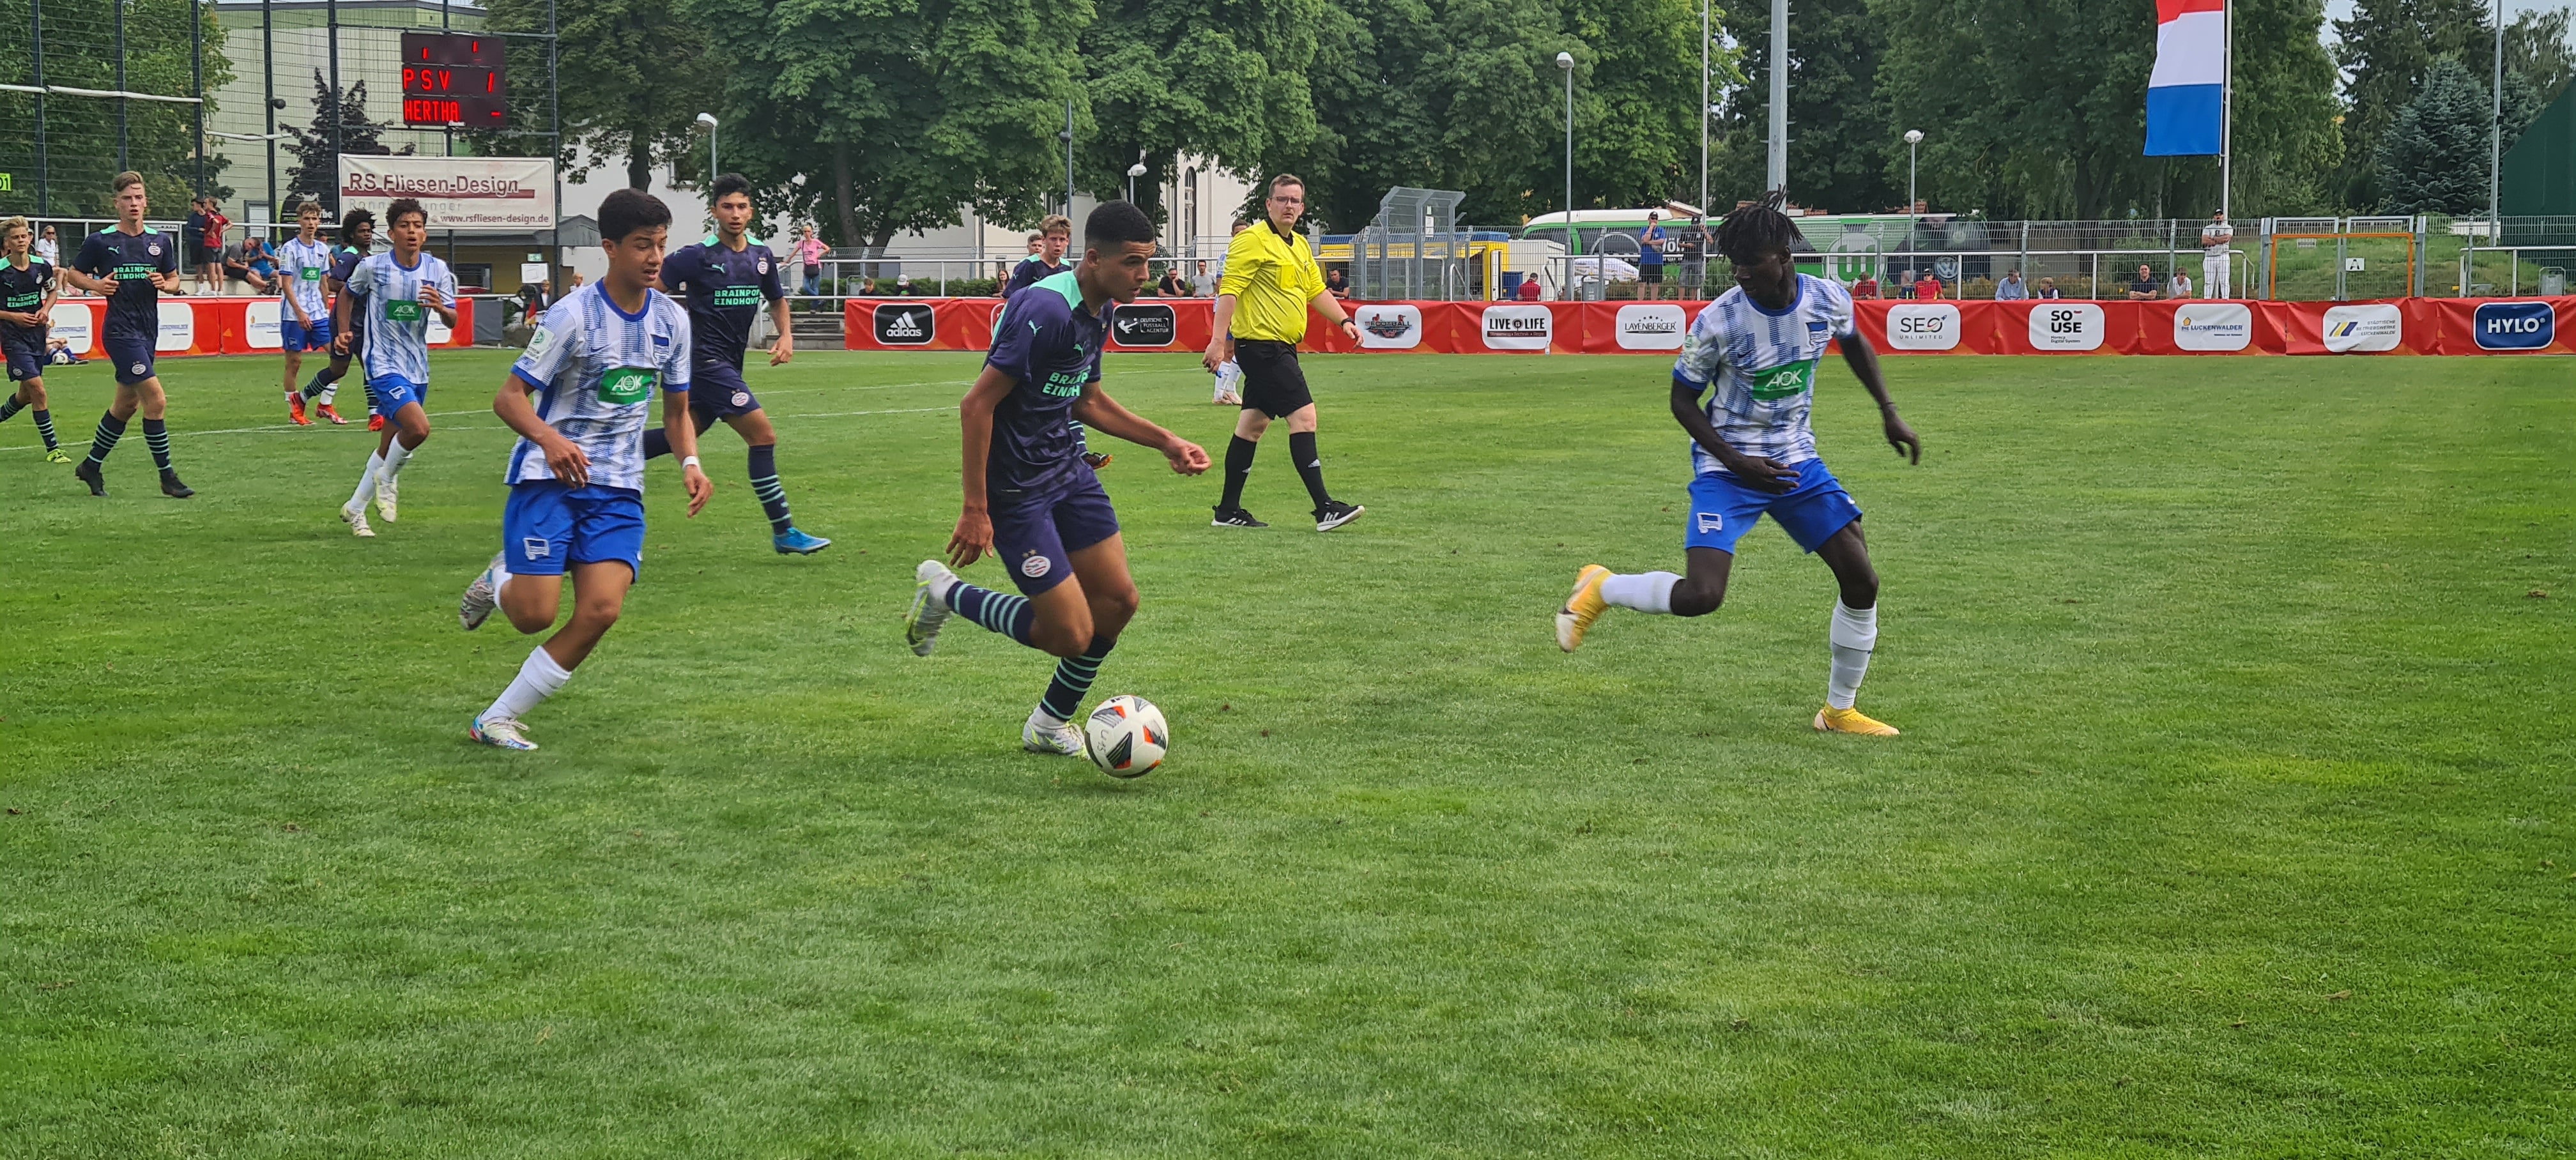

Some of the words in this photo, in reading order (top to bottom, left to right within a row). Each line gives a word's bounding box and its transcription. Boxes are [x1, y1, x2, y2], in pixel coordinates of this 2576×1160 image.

[404, 99, 461, 122] HERTHA
[350, 173, 376, 190] RS
[383, 174, 518, 196] Fliesen-Design
[440, 214, 549, 225] www.rsfliesen-design.de
[2350, 259, 2360, 270] A
[394, 305, 415, 314] AOK
[2051, 310, 2073, 321] SO
[1489, 318, 1510, 330] LIVE
[1524, 318, 1545, 329] LIFE
[1900, 317, 1943, 333] SEO
[2051, 322, 2082, 333] USE
[2487, 318, 2540, 333] HYLO
[886, 327, 922, 337] adidas
[611, 375, 643, 392] AOK
[1765, 369, 1803, 387] AOK
